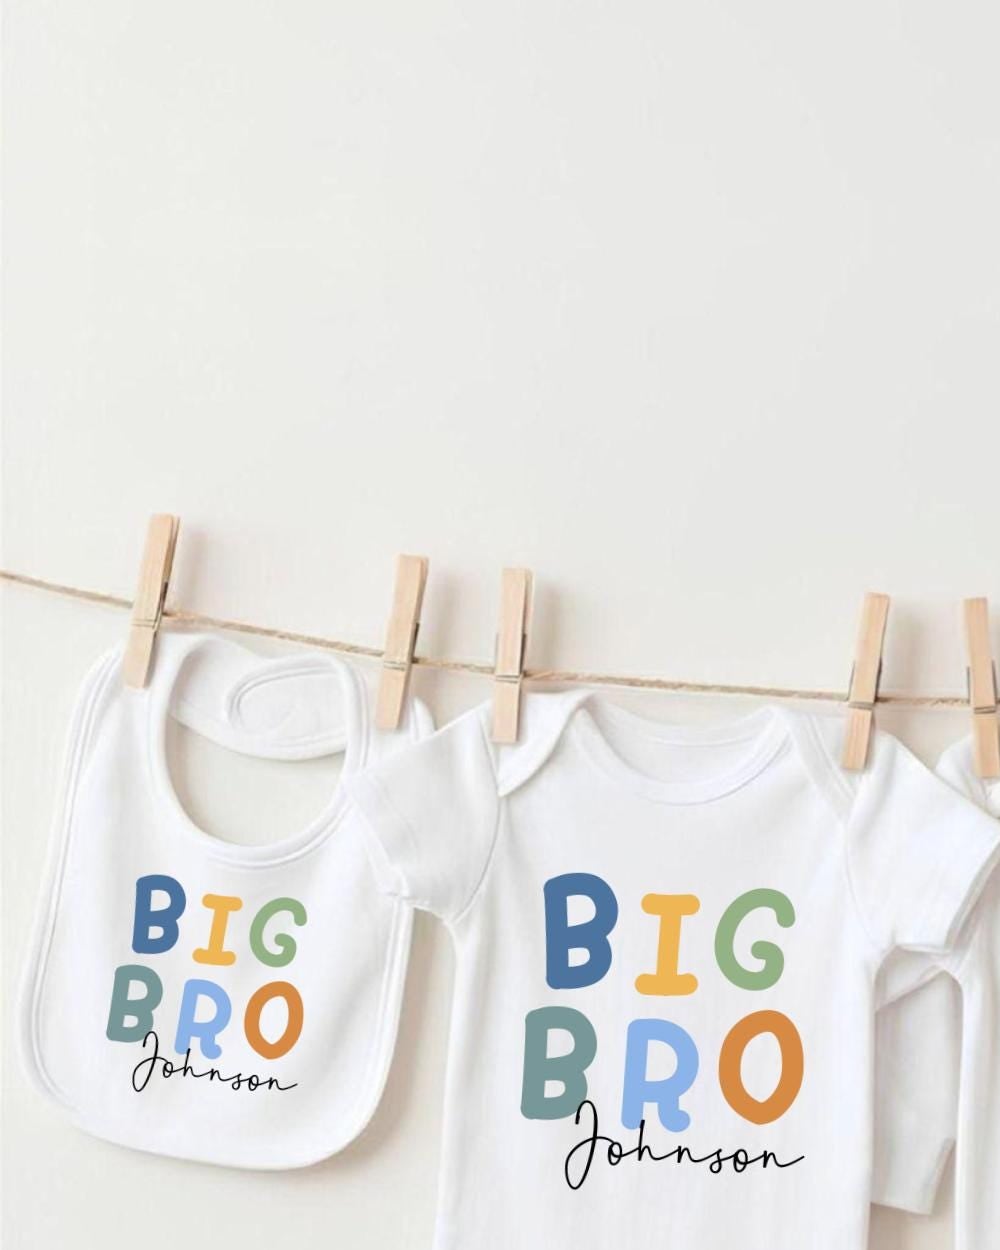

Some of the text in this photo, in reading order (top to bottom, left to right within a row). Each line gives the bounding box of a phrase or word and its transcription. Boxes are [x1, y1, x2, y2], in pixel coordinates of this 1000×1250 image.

[132, 874, 307, 968] BIG
[543, 872, 795, 996] BIG
[106, 964, 303, 1060] BRO
[132, 1031, 297, 1093] Johnson
[520, 1006, 804, 1133] BRO
[564, 1100, 805, 1190] Johnson
